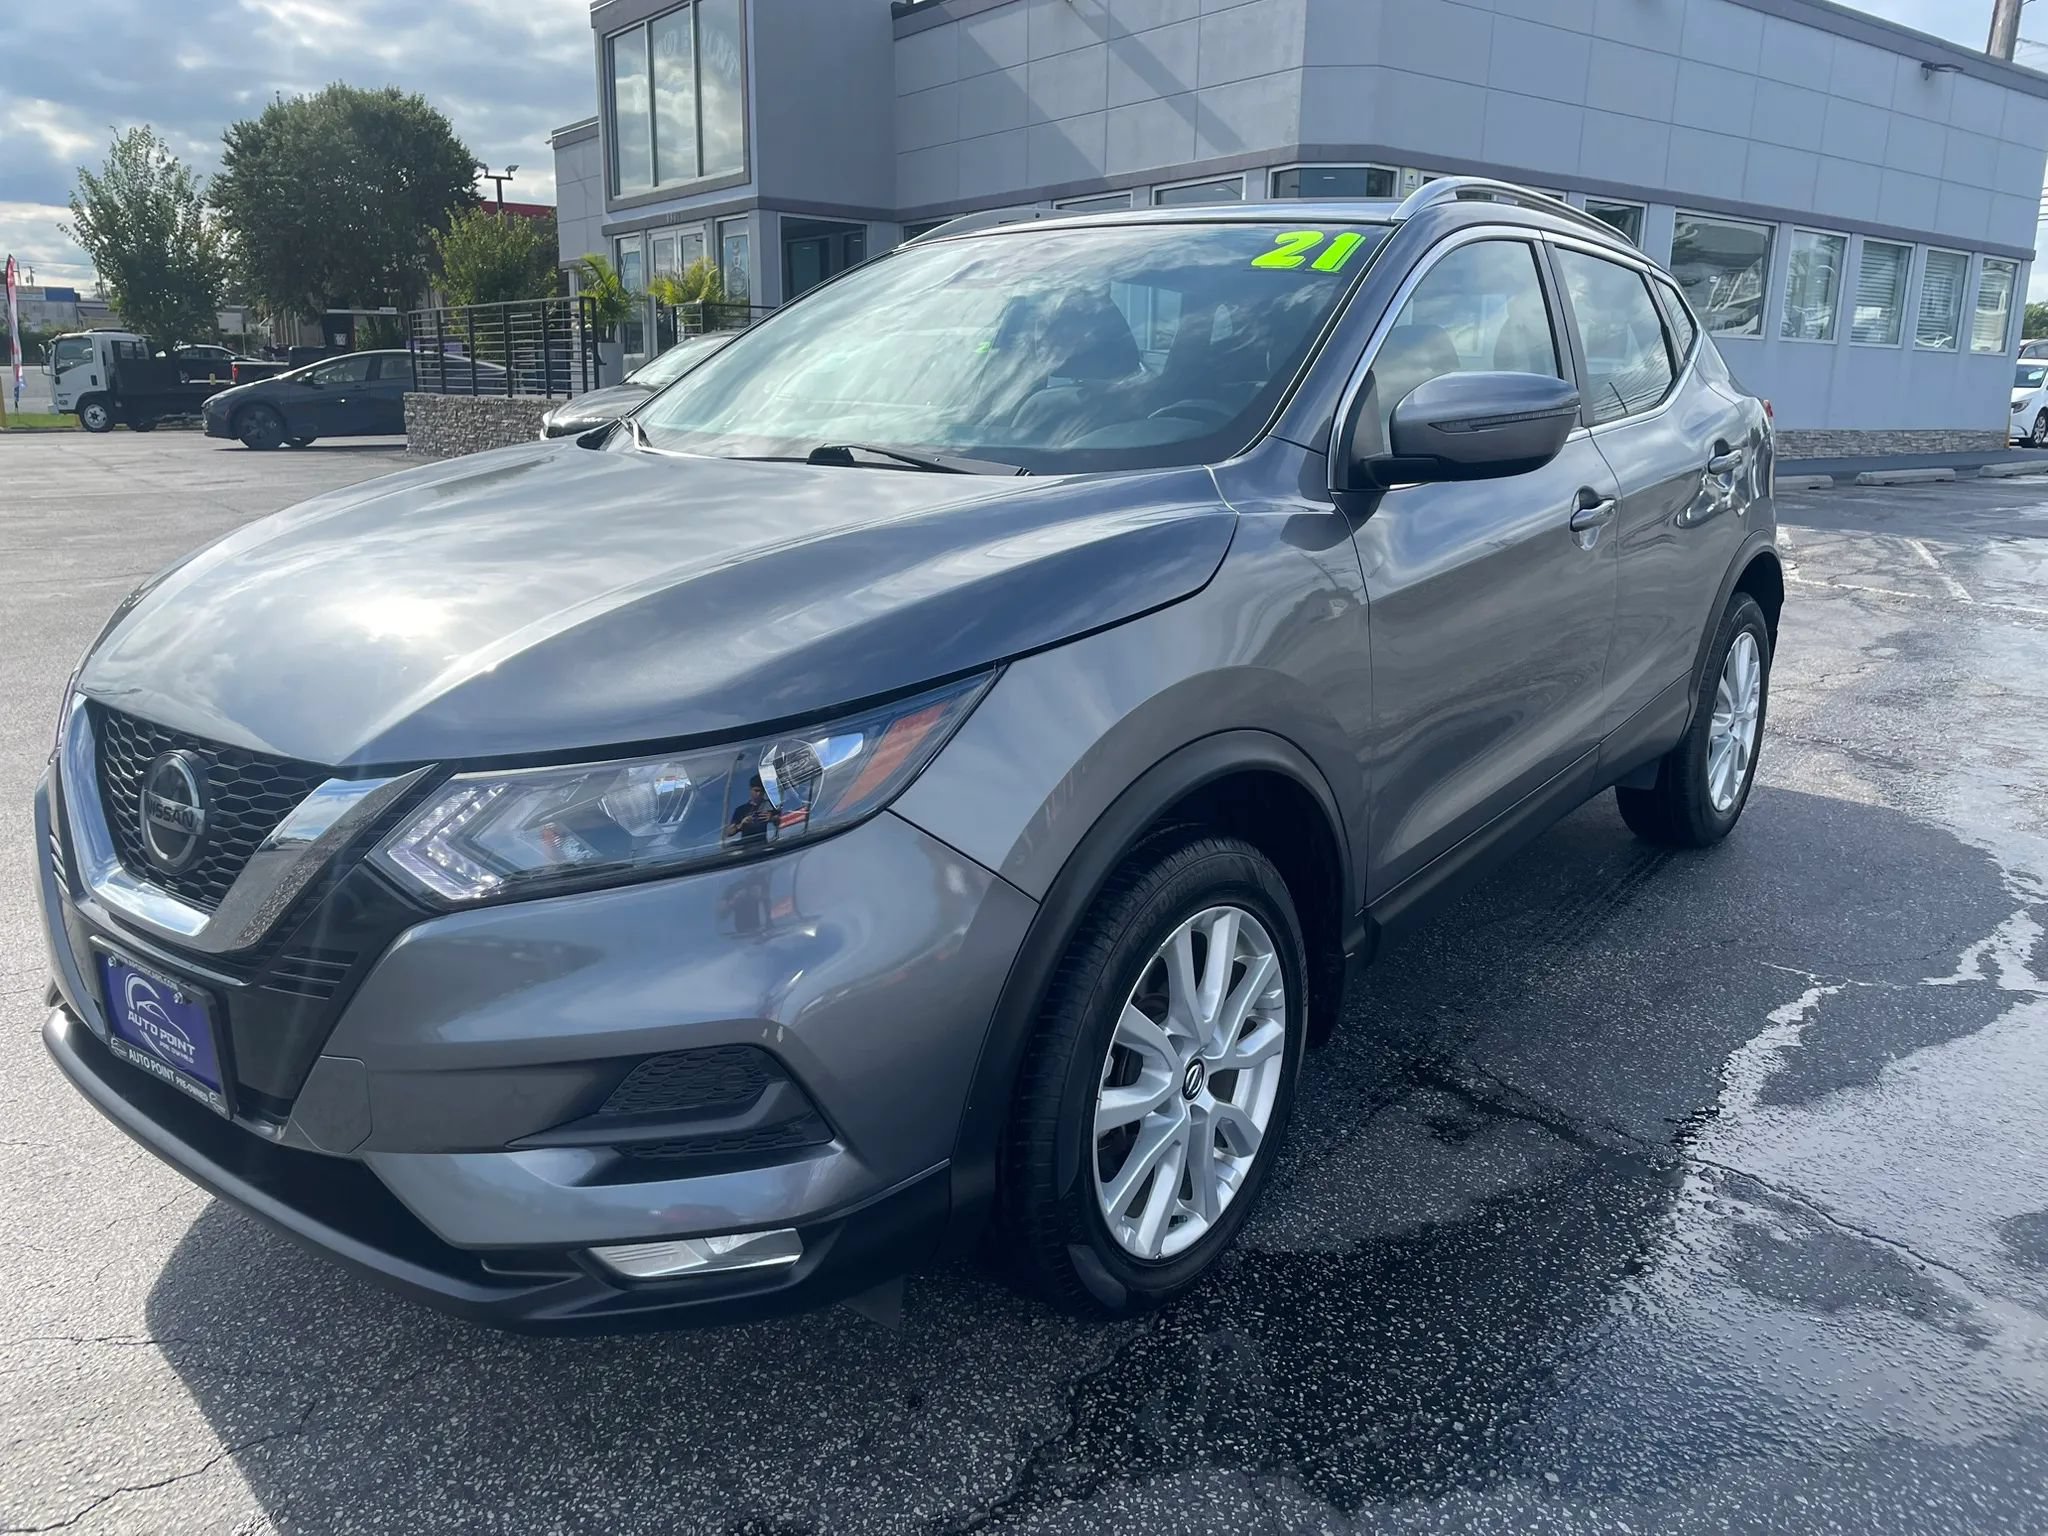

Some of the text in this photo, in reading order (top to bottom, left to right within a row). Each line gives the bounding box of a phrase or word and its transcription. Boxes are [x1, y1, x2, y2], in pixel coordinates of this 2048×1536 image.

[1251, 230, 1366, 272] 21
[128, 1010, 196, 1056] AUTO POINT
[128, 1049, 151, 1069] AUTO
[150, 1060, 175, 1081] POINT
